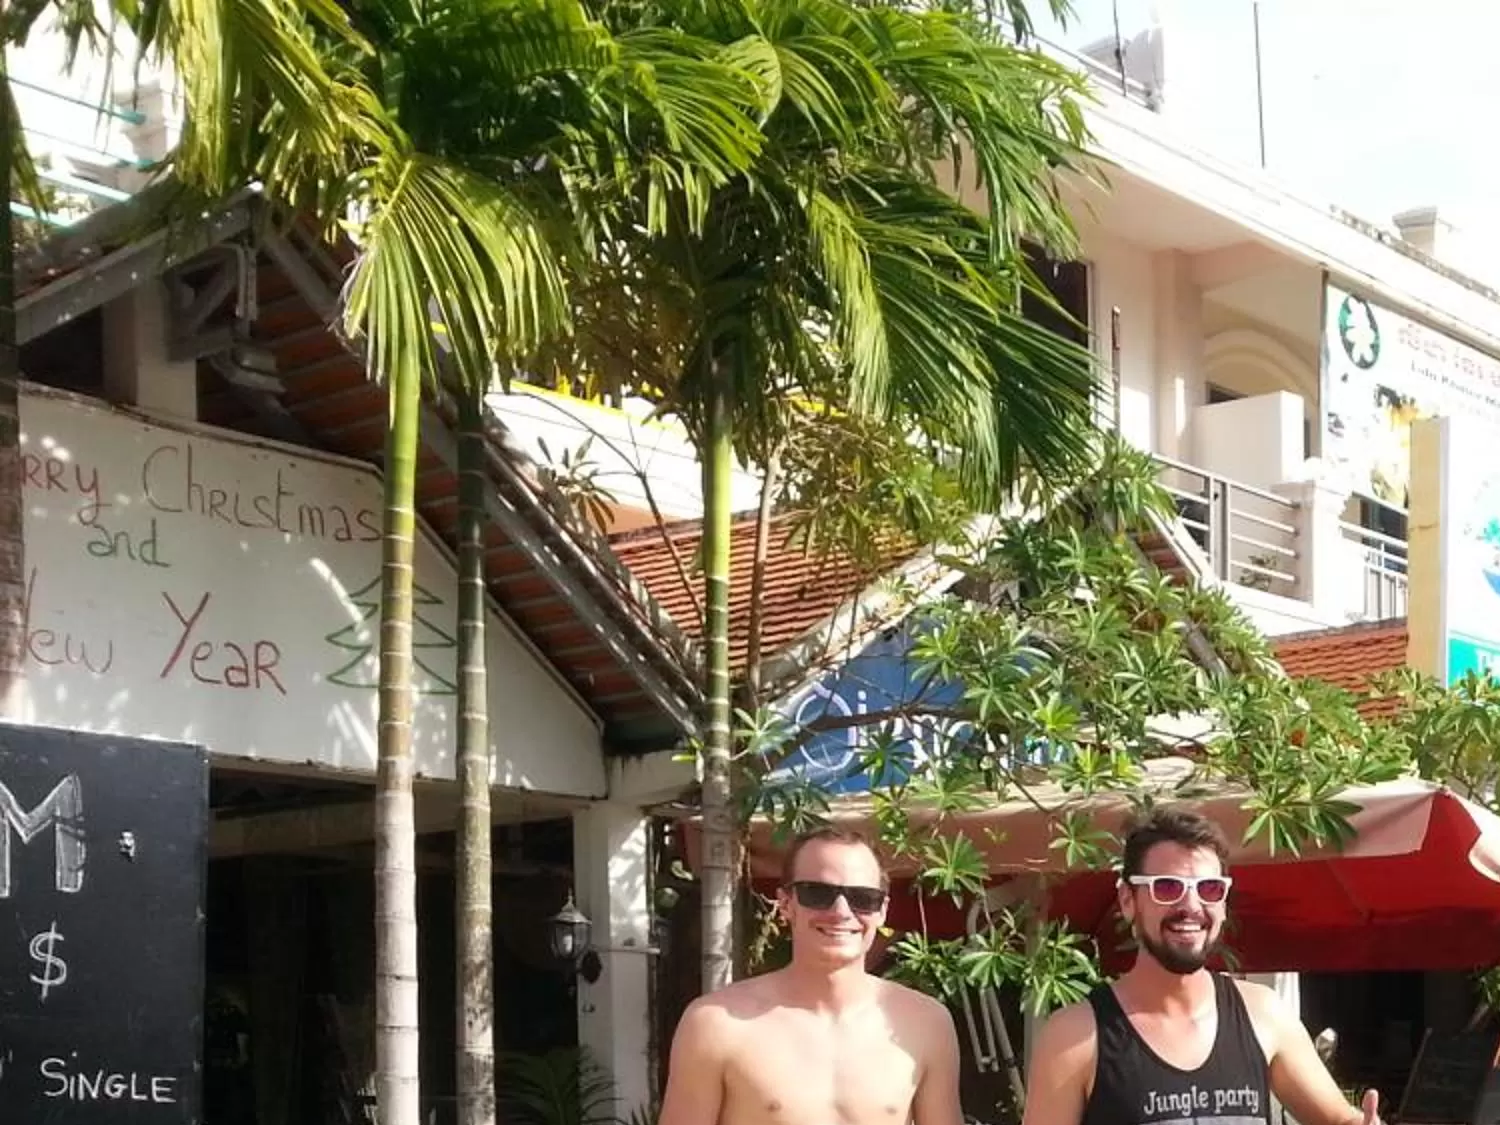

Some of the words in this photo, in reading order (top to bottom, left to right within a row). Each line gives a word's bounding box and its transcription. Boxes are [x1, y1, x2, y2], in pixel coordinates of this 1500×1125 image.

[86, 518, 172, 568] and
[29, 921, 67, 1001] $
[1143, 1085, 1209, 1116] Jungle
[1213, 1084, 1260, 1114] party
